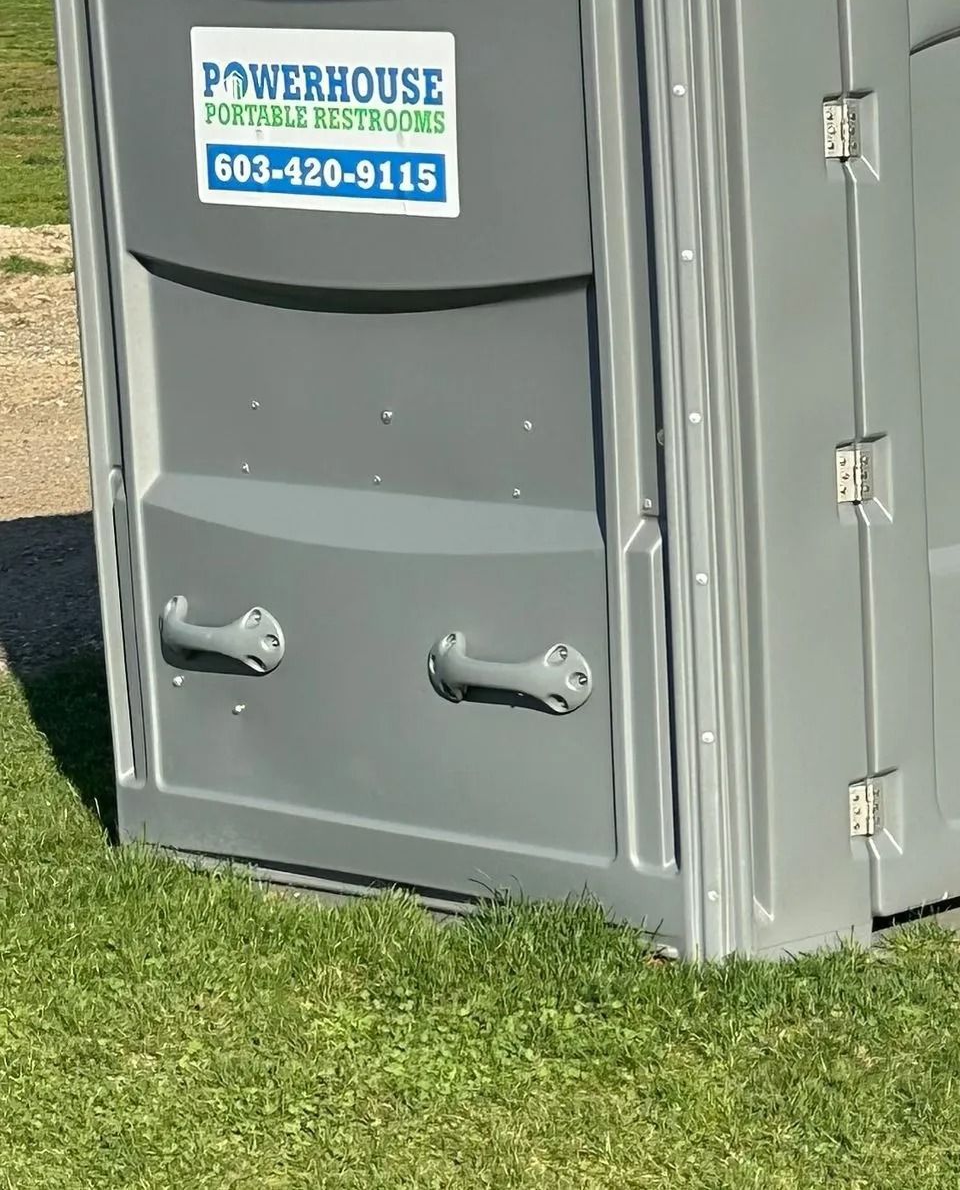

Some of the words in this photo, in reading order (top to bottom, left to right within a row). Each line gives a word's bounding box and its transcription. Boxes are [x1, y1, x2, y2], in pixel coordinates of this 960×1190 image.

[202, 61, 443, 105] POWERHOUSE
[205, 103, 308, 129] PORTABLE
[313, 106, 445, 134] RESTROOMS
[214, 153, 438, 193] 603-420-9115
